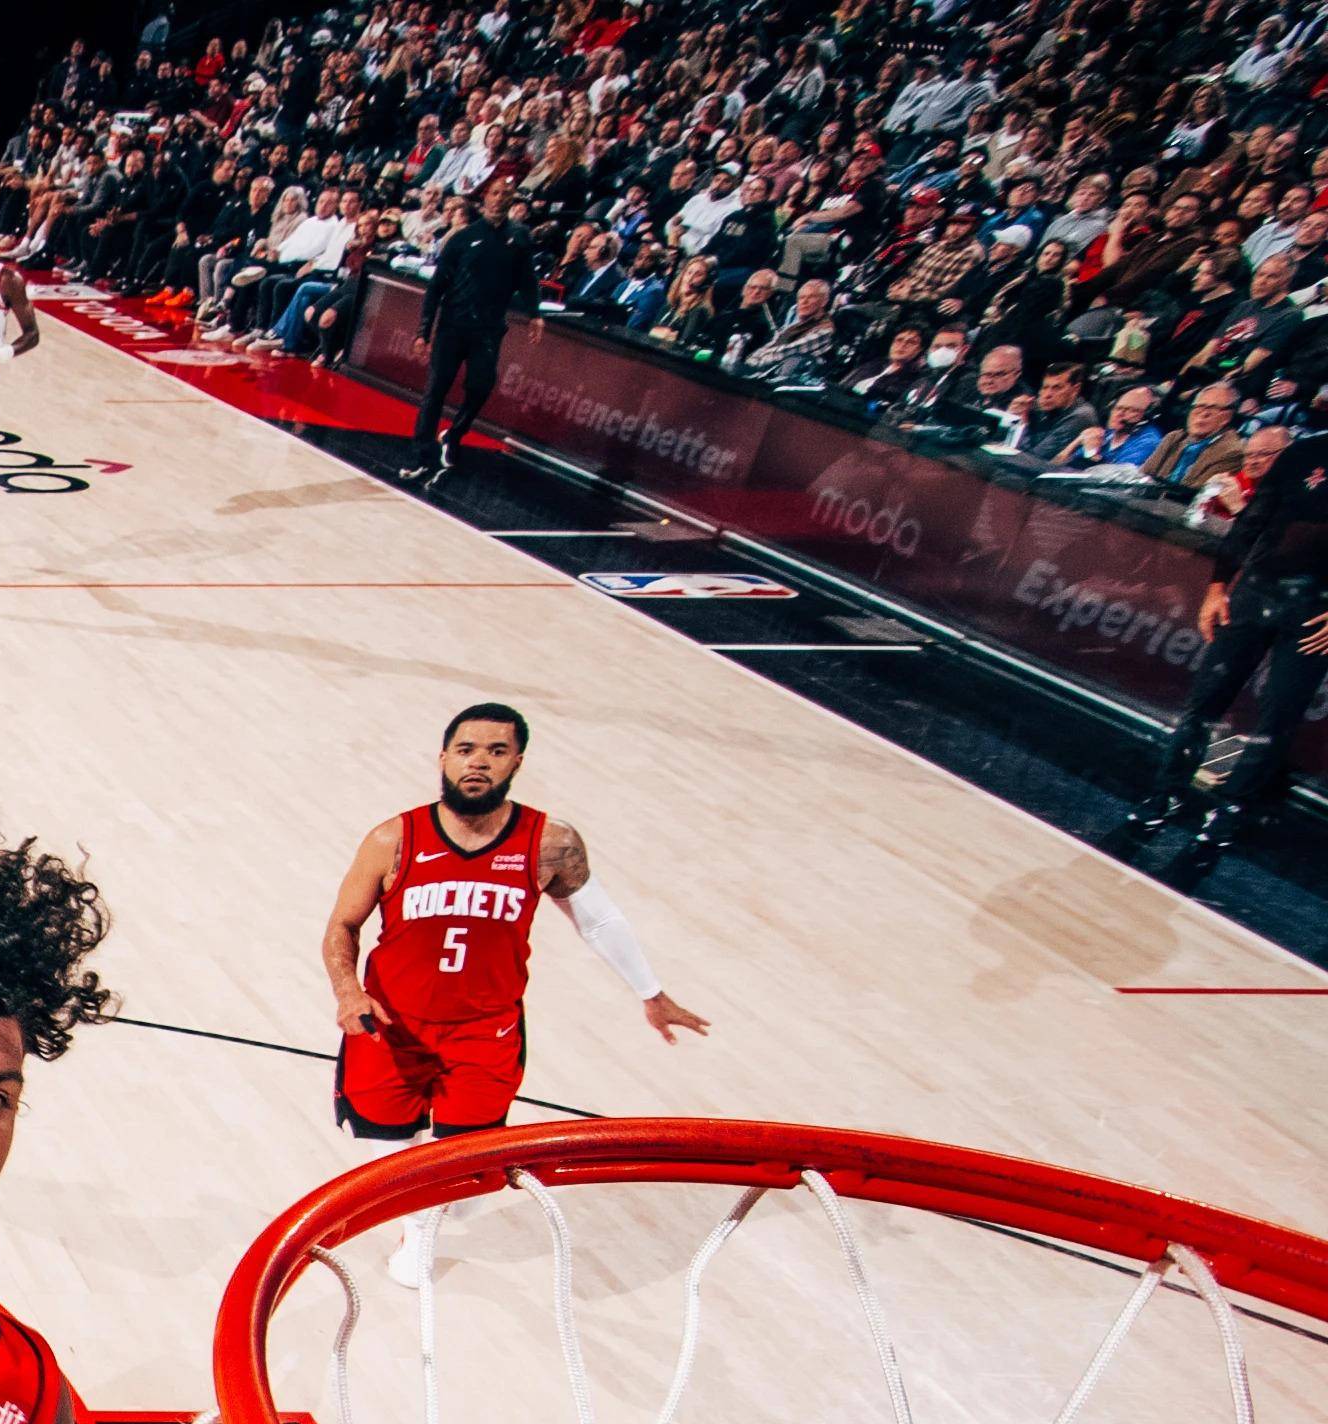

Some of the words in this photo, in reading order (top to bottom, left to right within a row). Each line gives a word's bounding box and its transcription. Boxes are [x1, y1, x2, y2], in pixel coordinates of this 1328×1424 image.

[637, 411, 737, 478] better
[809, 486, 922, 558] moda
[402, 880, 527, 923] ROCKETS
[438, 927, 469, 974] 5
